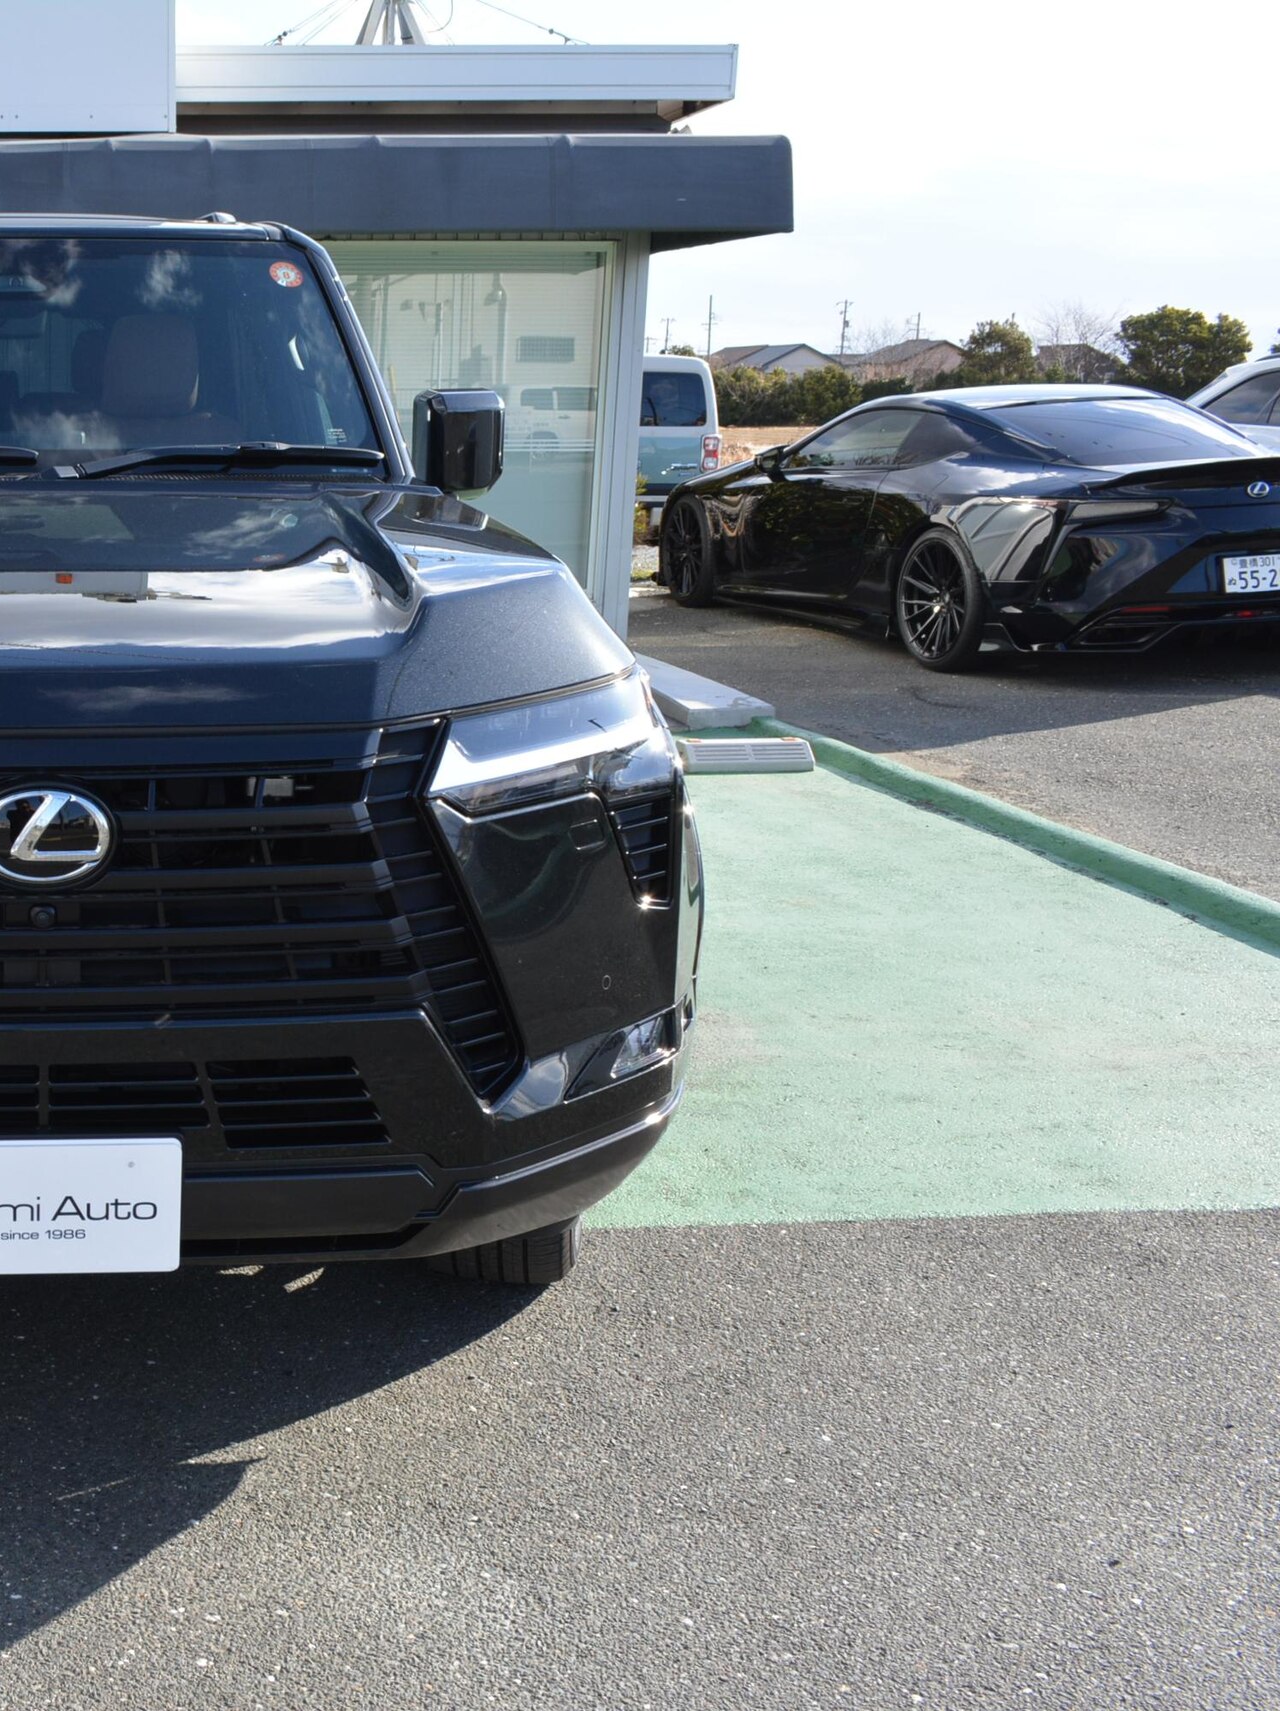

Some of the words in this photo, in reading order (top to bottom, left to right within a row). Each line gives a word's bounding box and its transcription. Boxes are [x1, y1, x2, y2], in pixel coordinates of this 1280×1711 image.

[51, 1195, 158, 1222] Auto
[0, 1231, 40, 1241] since
[45, 1229, 86, 1240] 1986
